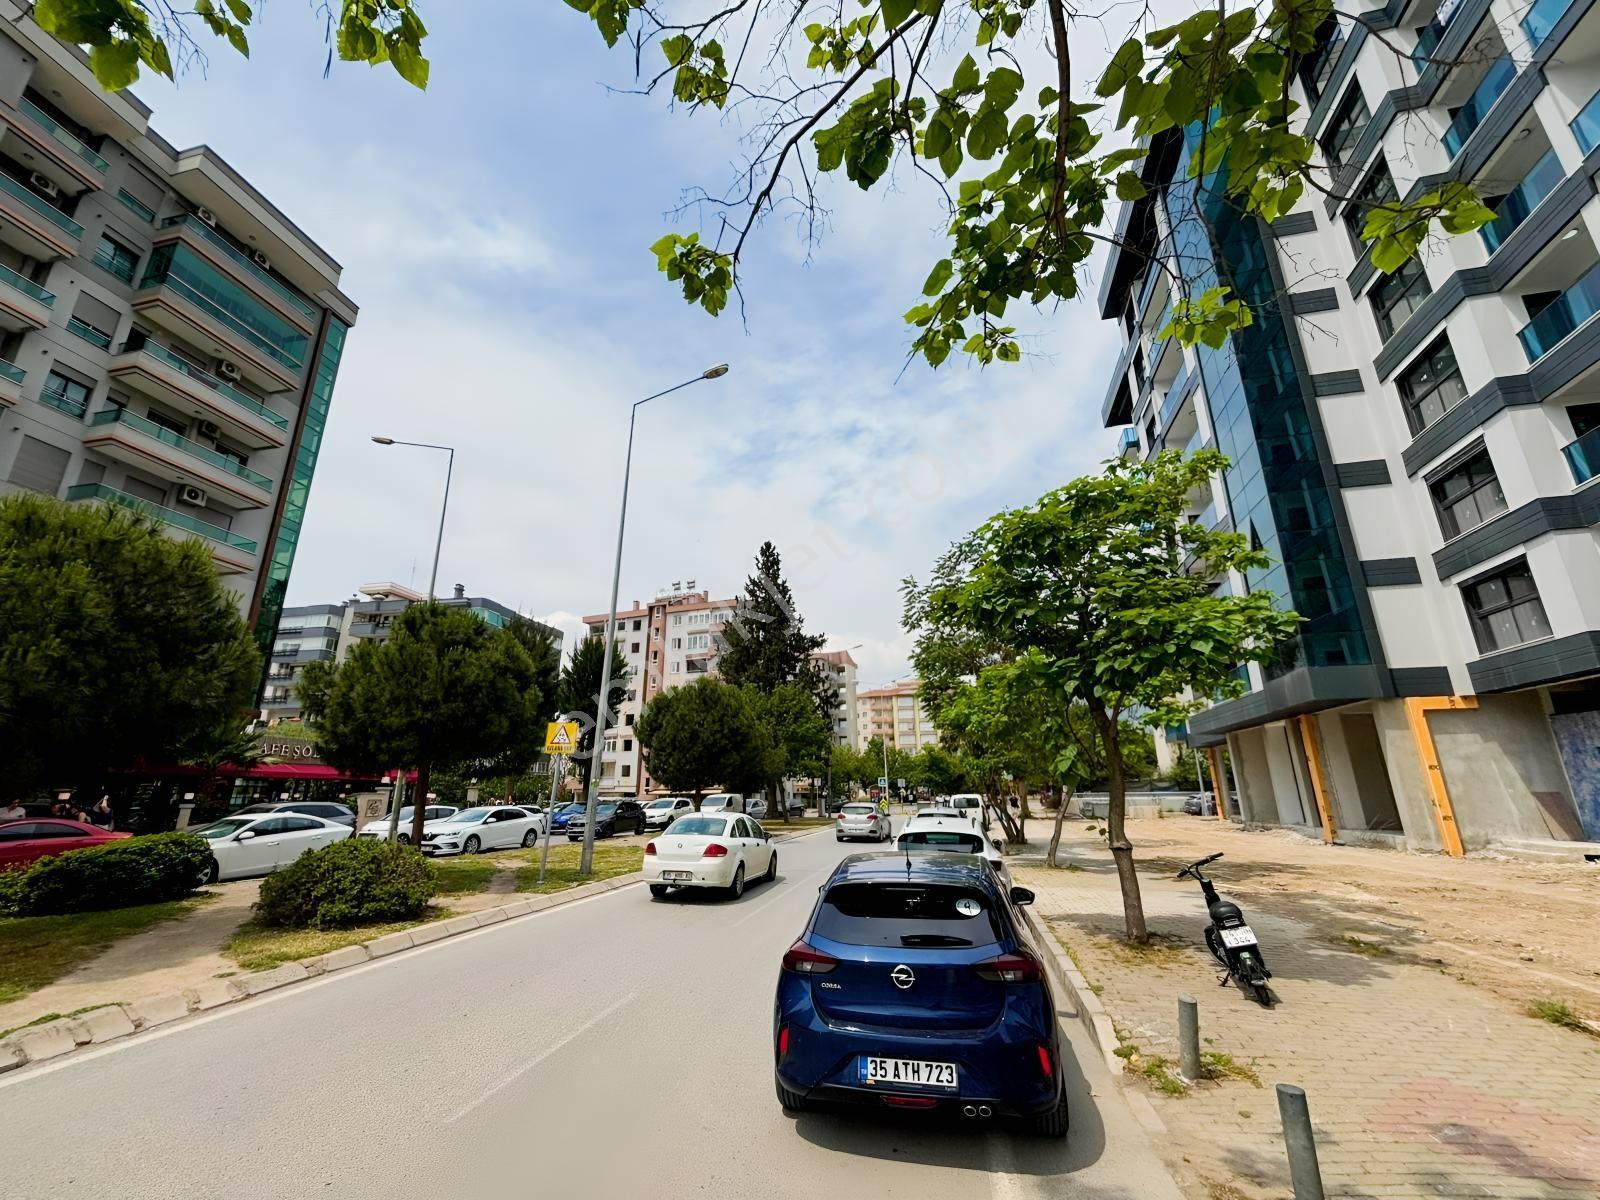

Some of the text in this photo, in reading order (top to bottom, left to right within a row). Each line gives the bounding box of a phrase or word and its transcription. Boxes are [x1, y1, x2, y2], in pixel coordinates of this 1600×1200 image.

[869, 1059, 888, 1079] 35
[893, 1061, 920, 1082] ATH
[925, 1063, 954, 1084] 723
